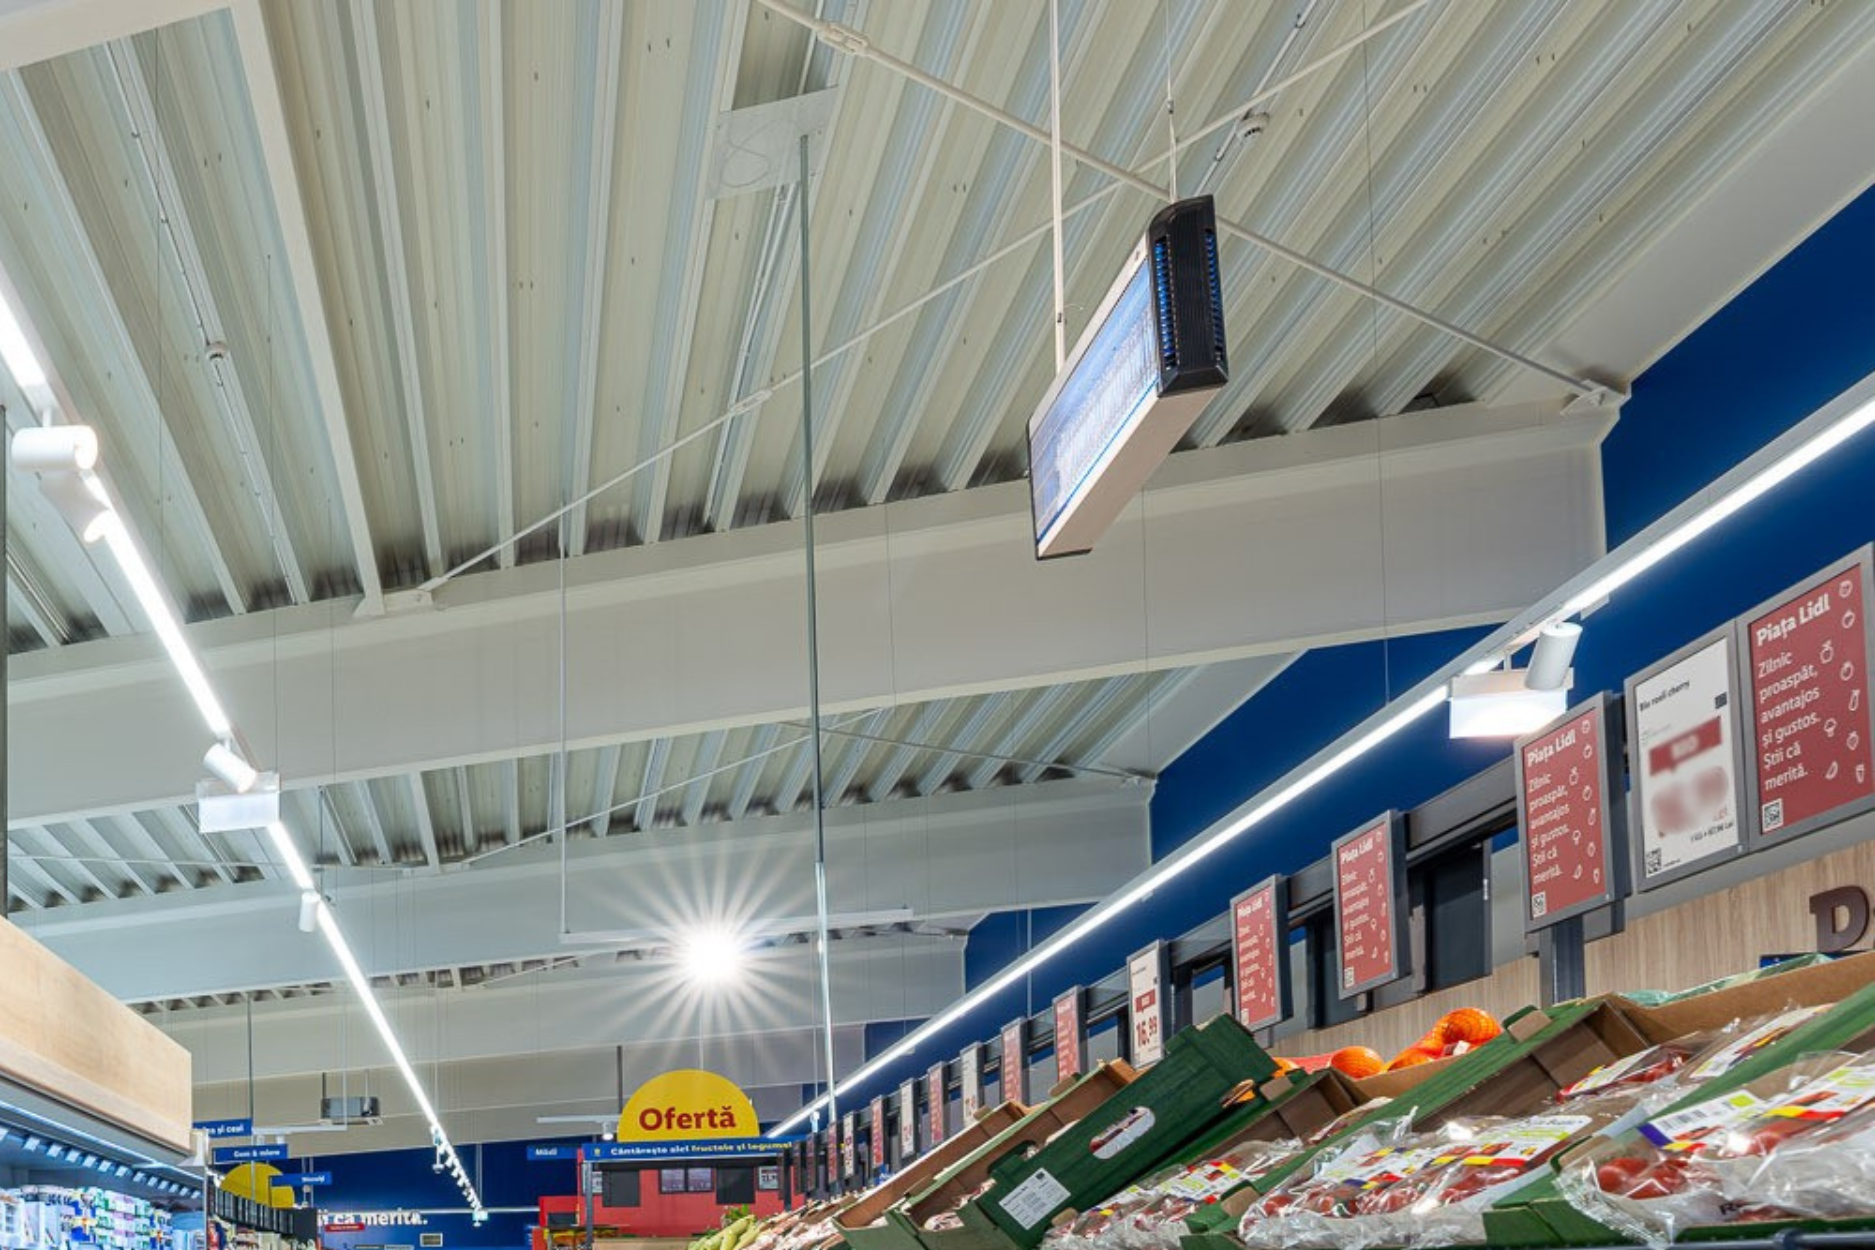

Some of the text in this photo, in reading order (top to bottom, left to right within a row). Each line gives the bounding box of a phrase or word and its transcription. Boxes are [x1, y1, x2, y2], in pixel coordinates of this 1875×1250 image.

[1756, 594, 1830, 646] Piața Lidl
[1758, 651, 1793, 678] Zilnic
[1759, 663, 1818, 704] proaspăt,
[1760, 686, 1820, 723] avantajos
[1761, 711, 1820, 747] și gustos.
[1527, 728, 1576, 767] Piața Lidl
[1786, 742, 1801, 760] că
[1764, 763, 1808, 791] merită.
[1809, 885, 1875, 952] D
[639, 1105, 736, 1131] Ofertă
